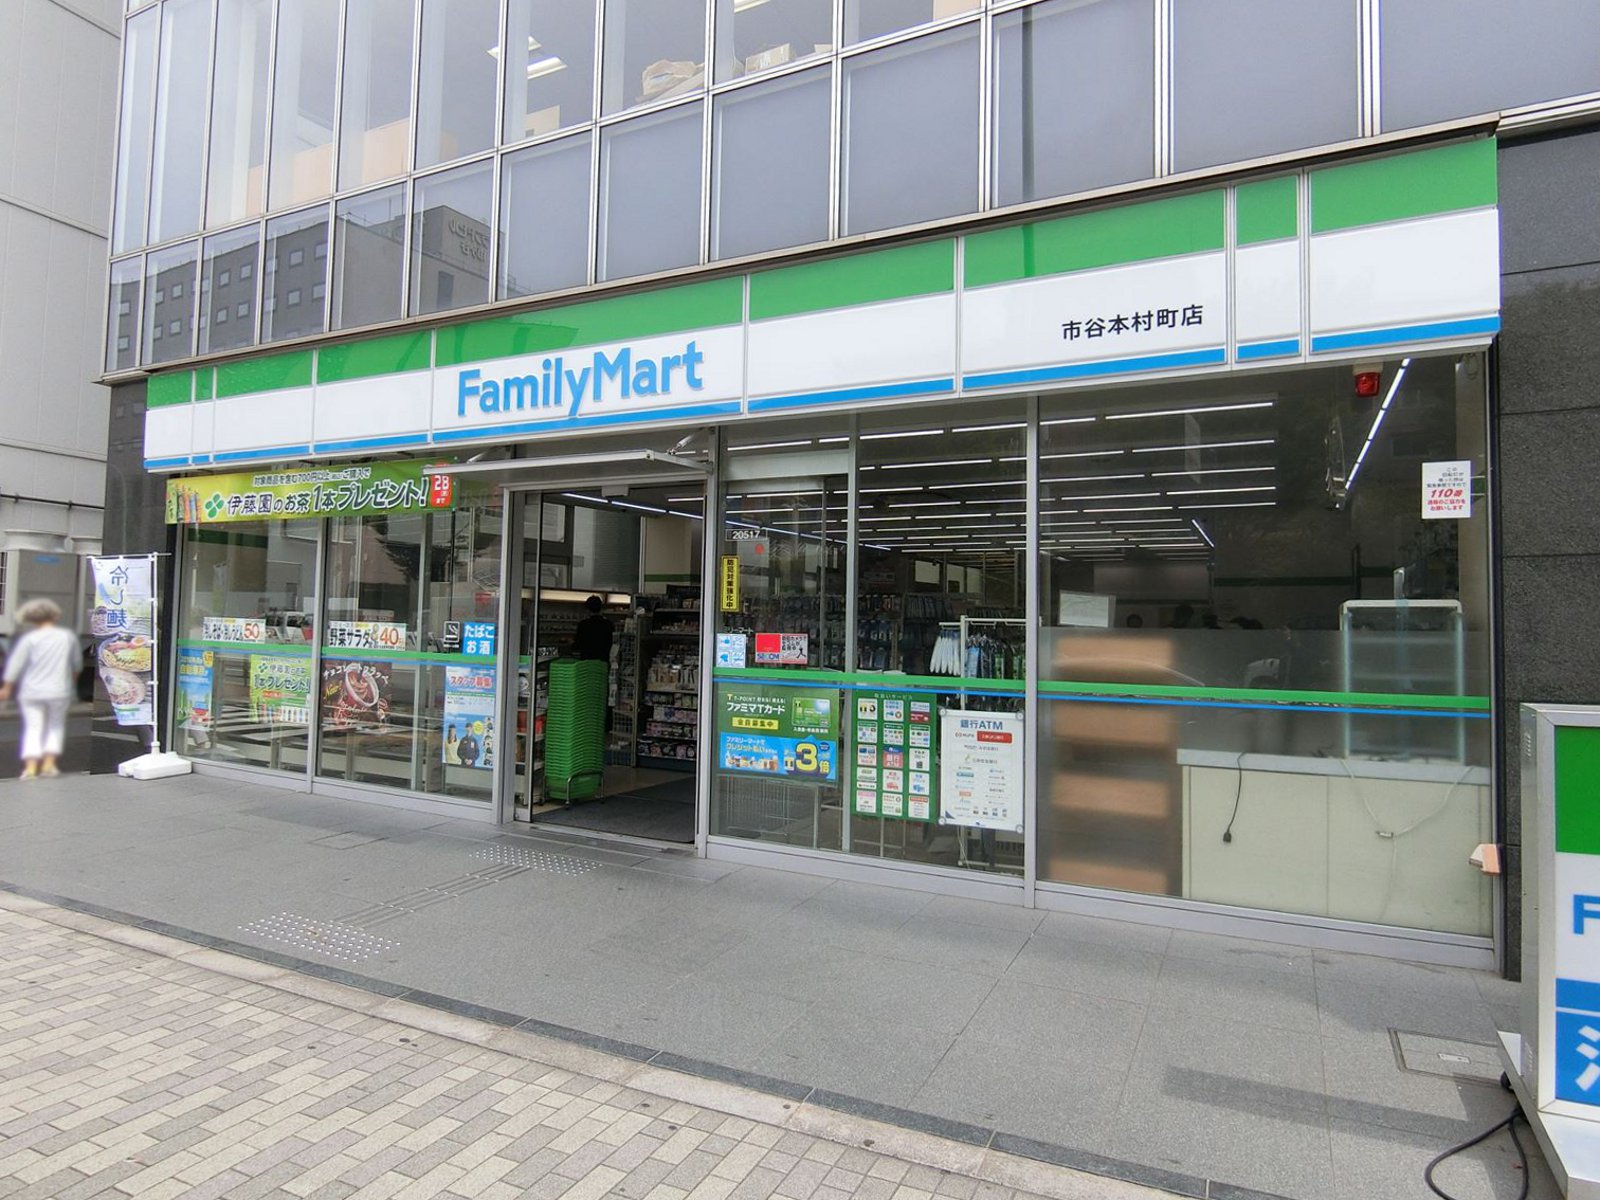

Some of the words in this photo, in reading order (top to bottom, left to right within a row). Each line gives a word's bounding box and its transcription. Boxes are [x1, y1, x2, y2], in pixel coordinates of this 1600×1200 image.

[1062, 304, 1203, 341] 市谷本村町店
[458, 340, 704, 418] FamilyMart
[434, 475, 449, 490] 28
[732, 530, 761, 540] 20517
[464, 624, 495, 638] たばこ
[466, 640, 491, 655] お酒
[726, 702, 786, 715] ファミマTカード
[960, 719, 1003, 730] 銀行ATM
[797, 742, 818, 772] 3
